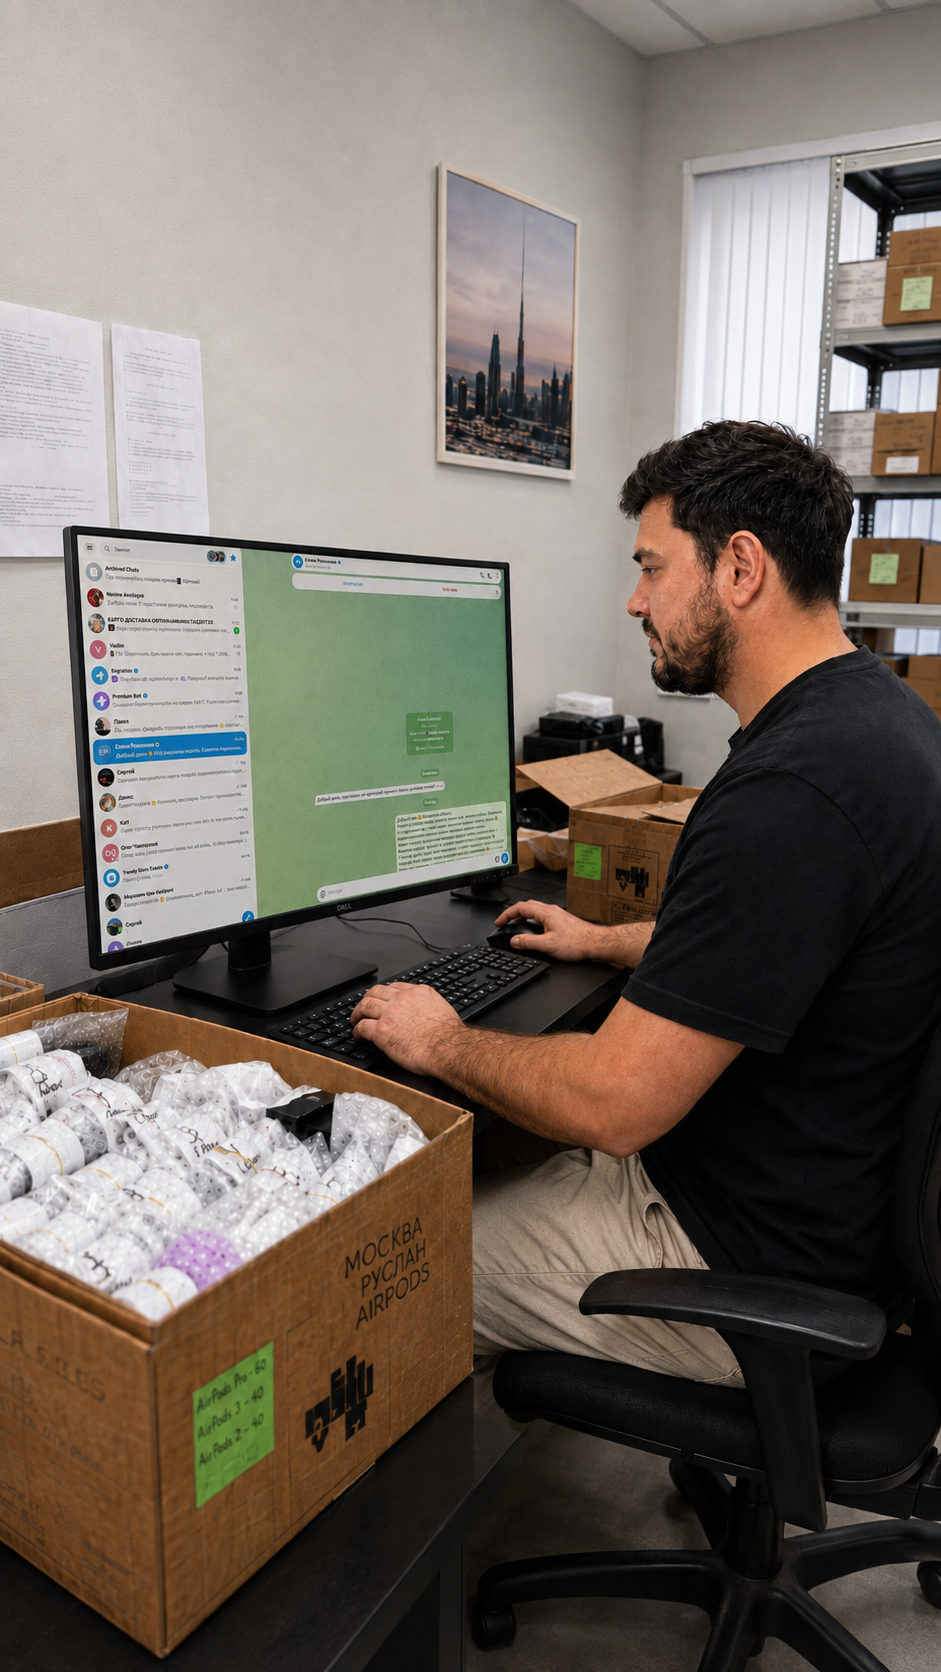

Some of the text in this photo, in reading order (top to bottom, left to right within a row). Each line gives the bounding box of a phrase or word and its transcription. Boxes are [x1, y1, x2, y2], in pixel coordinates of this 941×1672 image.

[345, 1216, 423, 1279] МОСКВА
[361, 1238, 426, 1298] РУСЛАН
[355, 1261, 430, 1330] AIRPODS
[196, 1381, 232, 1415] AirPods
[233, 1372, 248, 1389] Pro
[254, 1358, 267, 1375] 60
[198, 1408, 232, 1442] AirPods
[234, 1401, 241, 1415] 3
[251, 1385, 264, 1403] 40
[198, 1436, 233, 1469] AirPods
[235, 1428, 242, 1442] 2
[251, 1412, 264, 1429] 40
